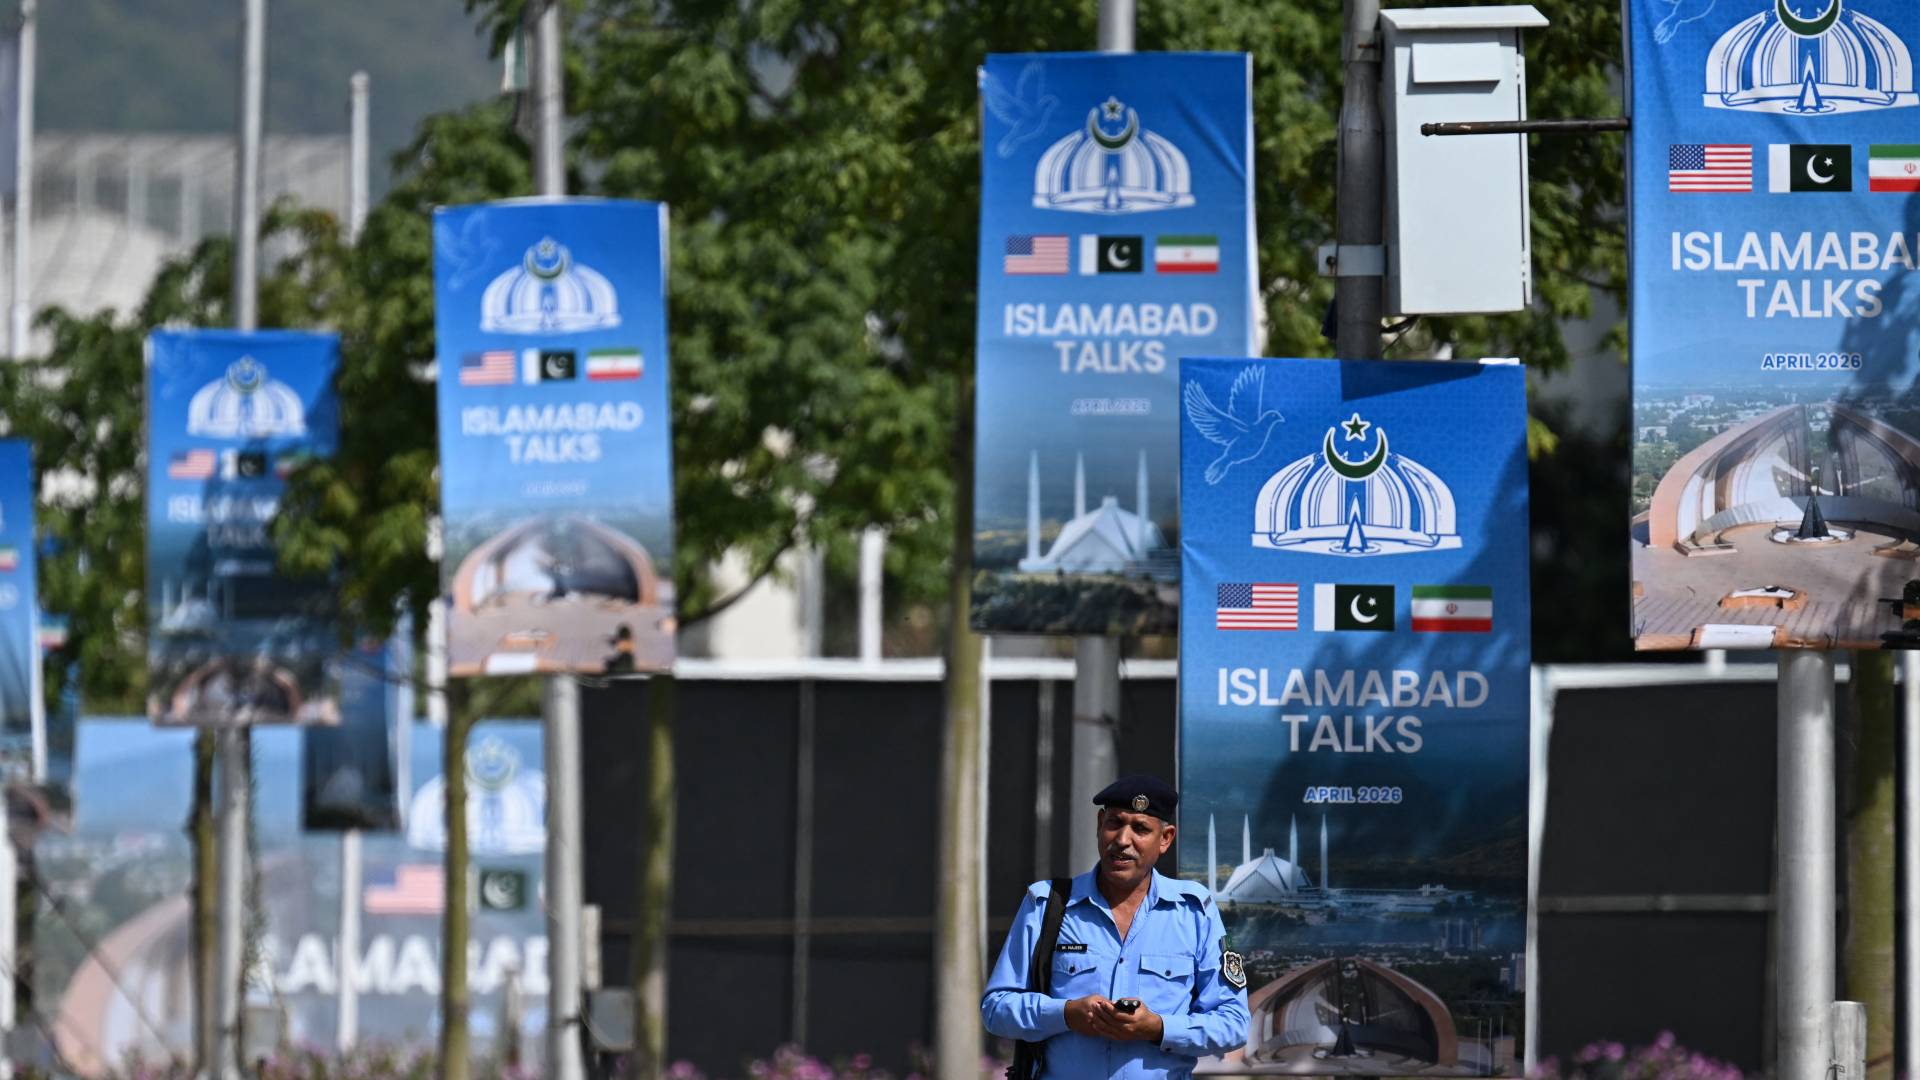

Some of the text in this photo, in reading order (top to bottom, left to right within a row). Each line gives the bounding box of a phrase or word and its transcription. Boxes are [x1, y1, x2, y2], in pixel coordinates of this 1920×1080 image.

[1672, 230, 1920, 271] ISLAMABA
[1737, 278, 1883, 319] TALKS
[1003, 302, 1218, 337] ISLAMABAD
[1054, 340, 1167, 374] TALKS
[1761, 353, 1862, 371] APRIL 2026
[461, 401, 644, 437] ISLAMABAD
[505, 432, 602, 465] TALKS
[1218, 667, 1490, 708] ISLAMABAD
[1282, 714, 1423, 753] TALKS
[1303, 786, 1402, 803] APRIL 2026
